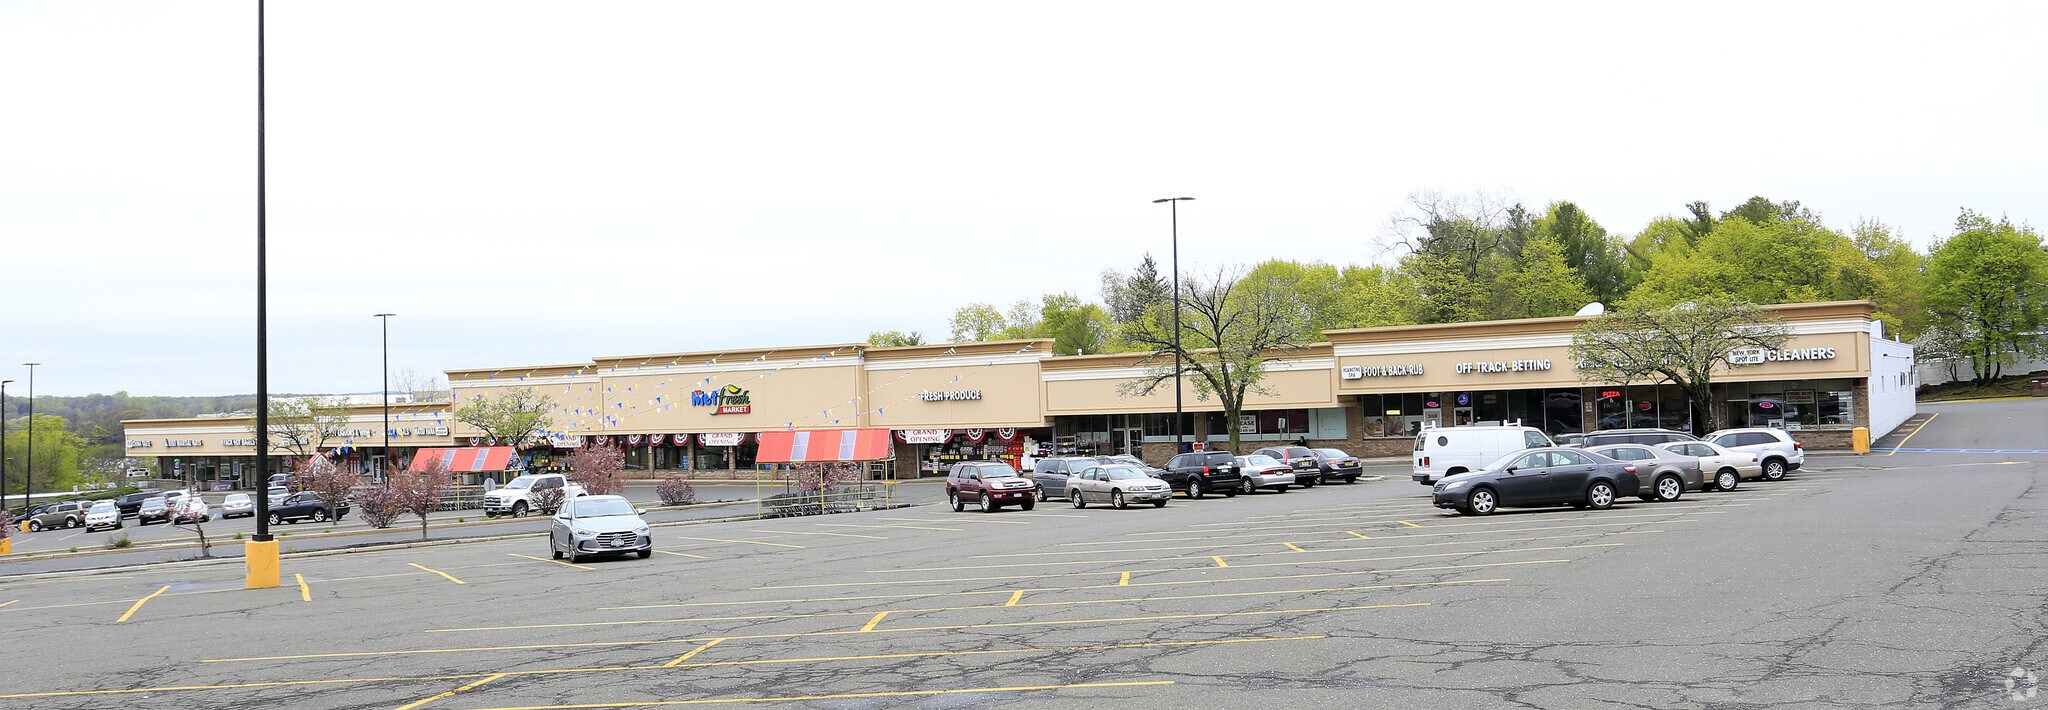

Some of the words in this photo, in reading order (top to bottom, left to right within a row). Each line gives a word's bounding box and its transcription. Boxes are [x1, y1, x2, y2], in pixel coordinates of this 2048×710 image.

[1767, 347, 1836, 361] CLEANERS
[1363, 366, 1381, 377] FOOT
[1381, 367, 1387, 376] &
[1388, 365, 1407, 376] BACK
[1409, 364, 1424, 375] RUB
[1456, 362, 1473, 374] OFF
[1476, 361, 1508, 373] TRACK
[1512, 359, 1551, 371] BETTING
[920, 391, 944, 401] FRESH
[945, 389, 982, 401] PRODUCE
